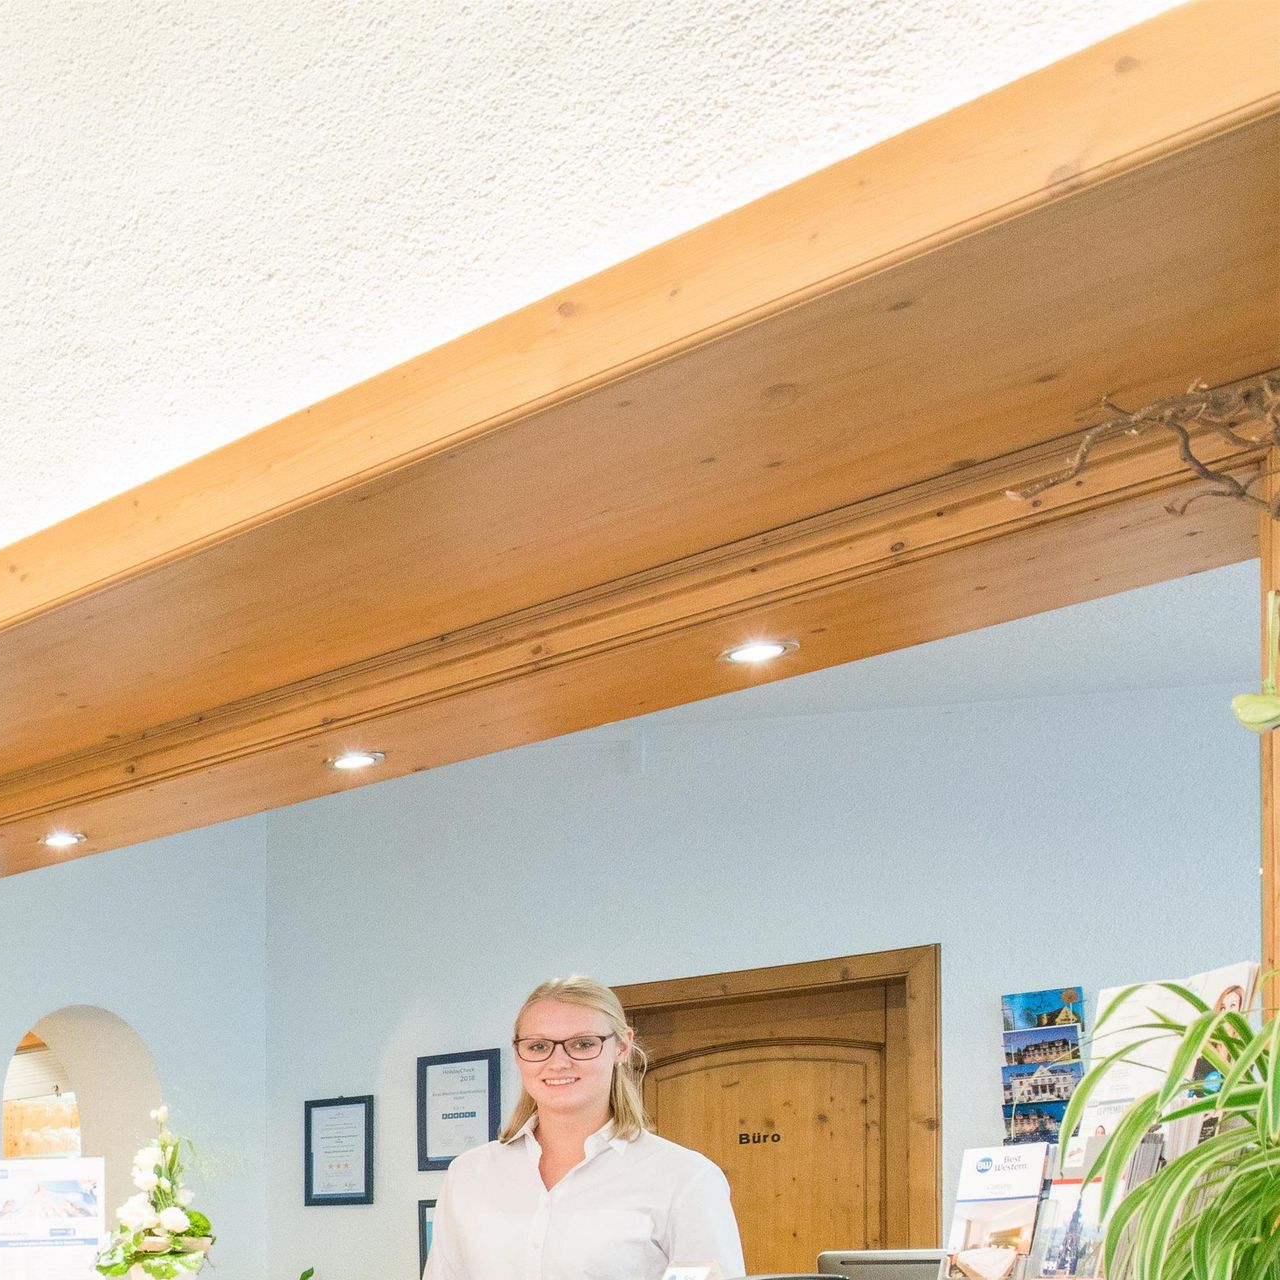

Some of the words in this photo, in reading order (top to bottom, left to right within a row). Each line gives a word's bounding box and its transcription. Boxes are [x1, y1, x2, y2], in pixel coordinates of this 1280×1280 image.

[739, 1132, 781, 1145] Büro
[1003, 1155, 1022, 1164] Best
[994, 1162, 1028, 1172] Western
